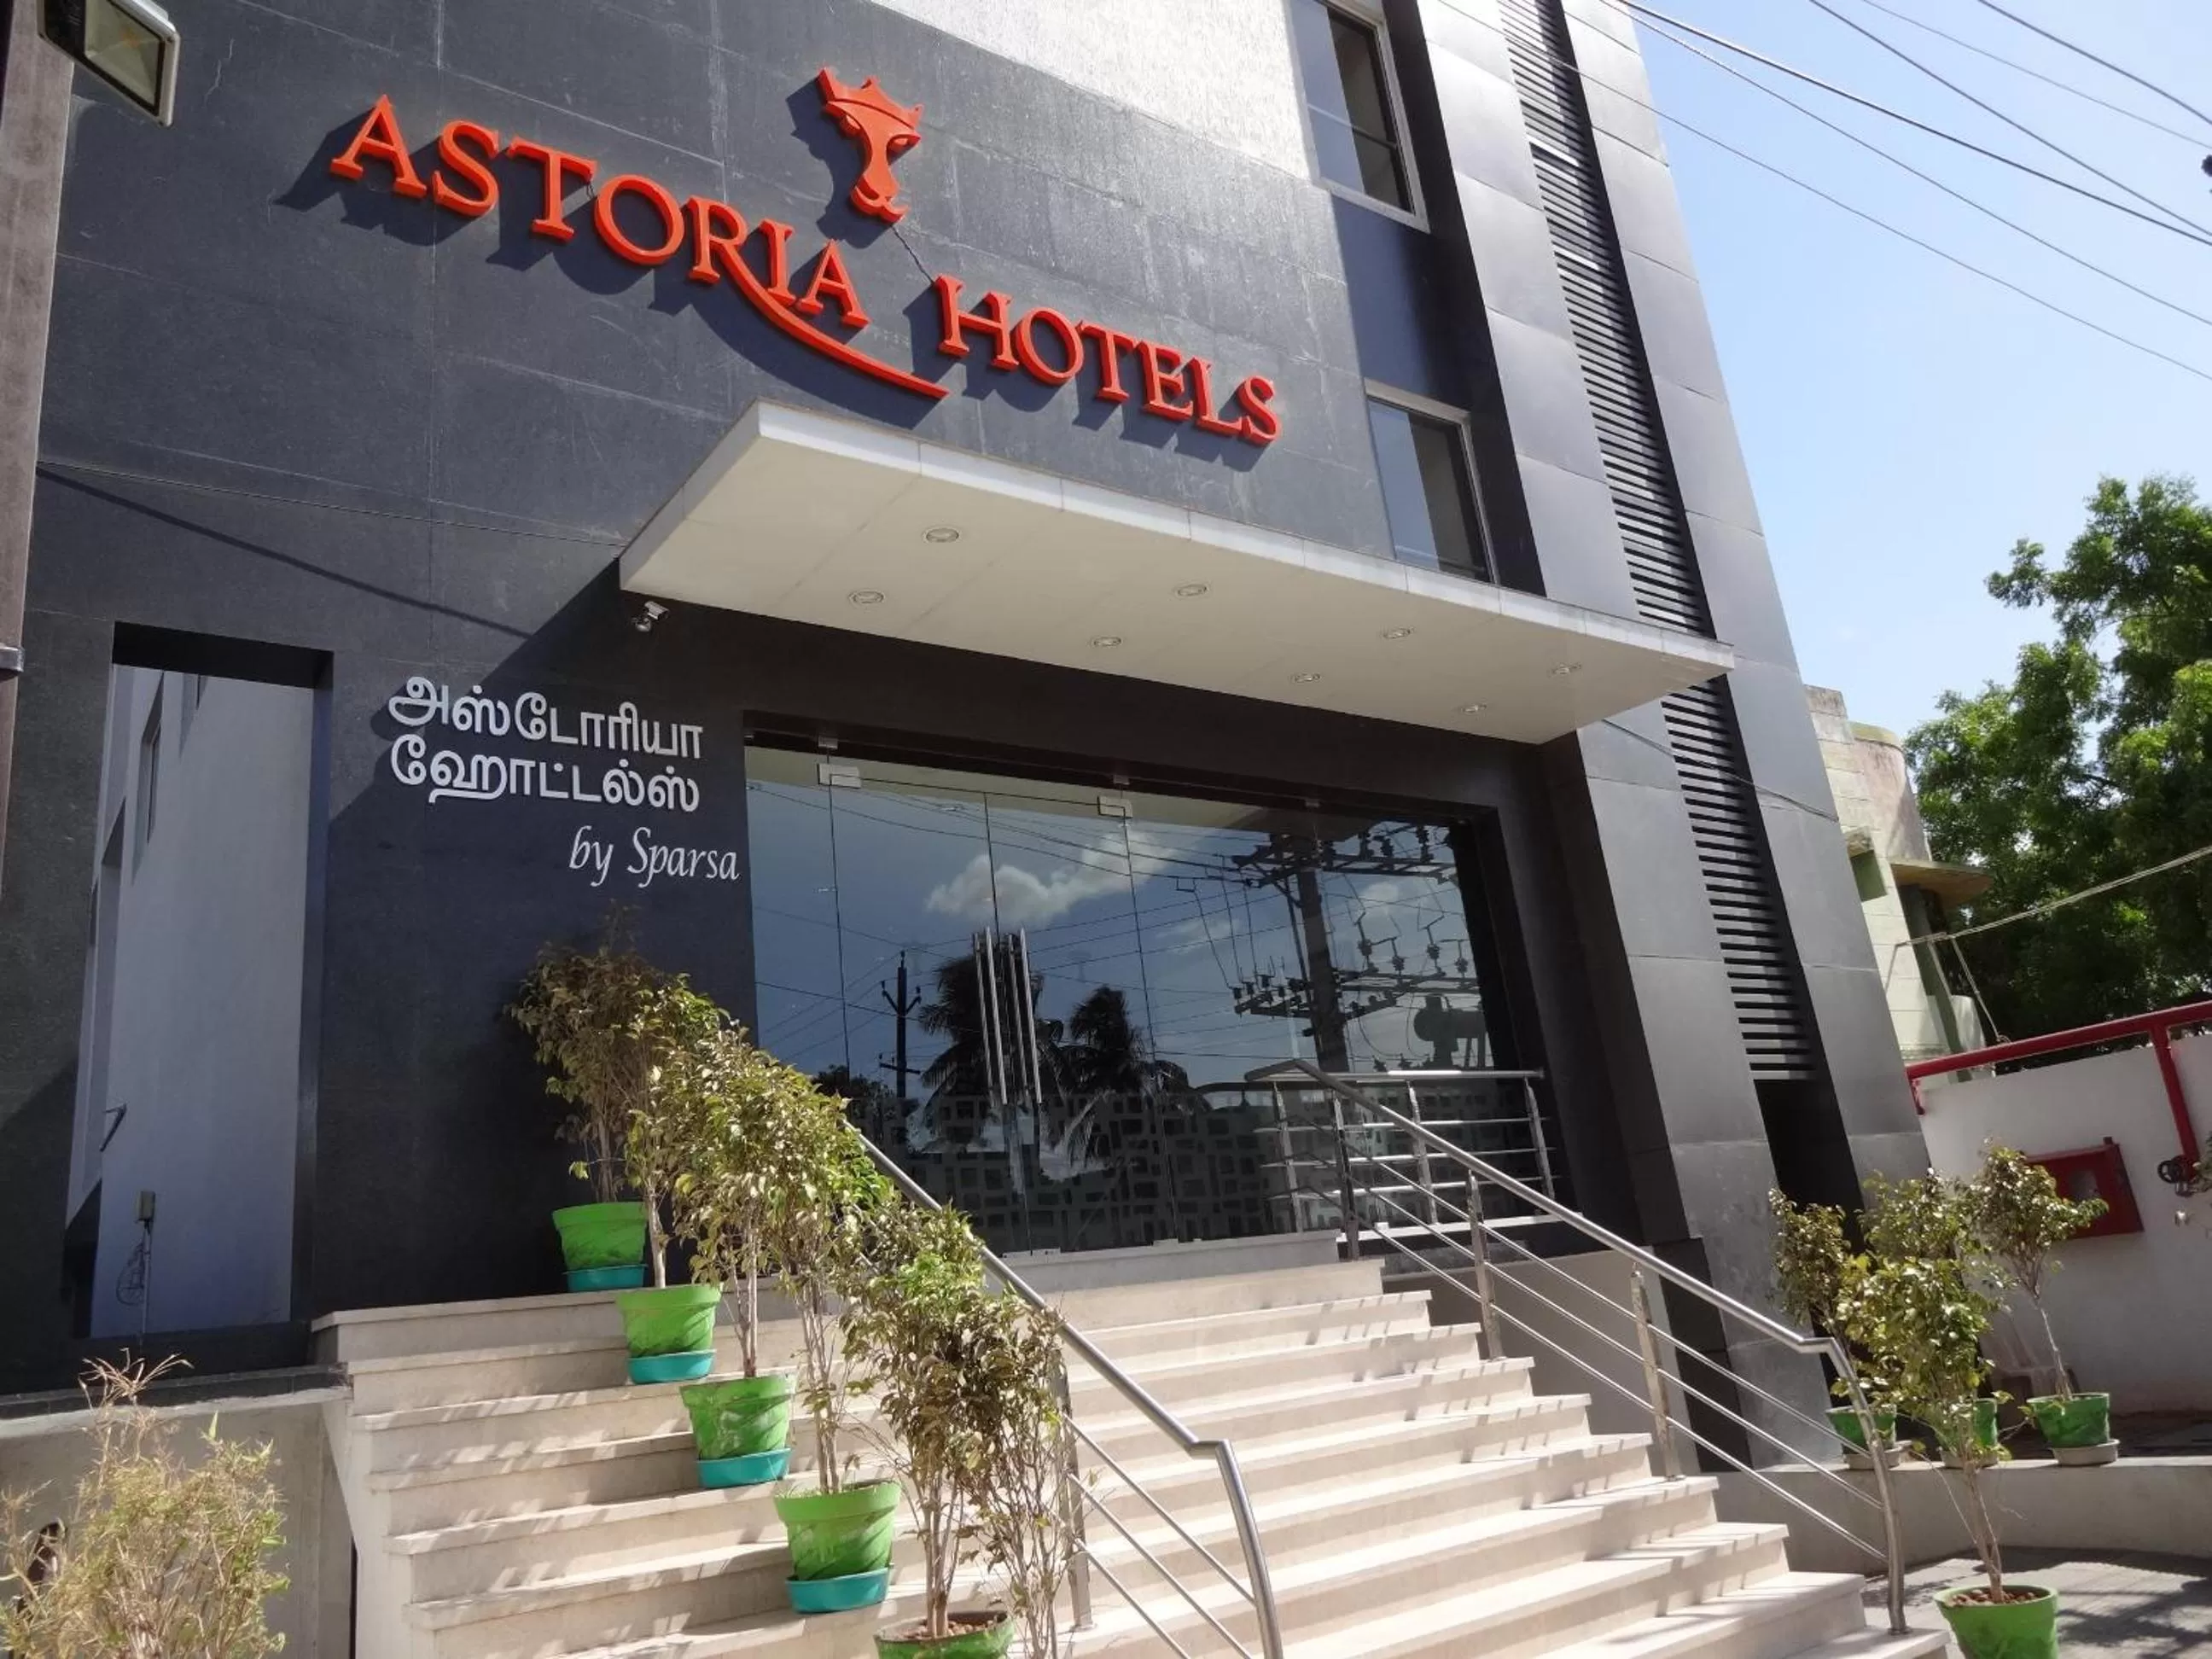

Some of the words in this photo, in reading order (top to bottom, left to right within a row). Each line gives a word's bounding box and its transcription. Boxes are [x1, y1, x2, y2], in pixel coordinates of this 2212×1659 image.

[330, 96, 948, 398] ASTORIA
[935, 275, 1280, 443] HOTELS
[388, 676, 704, 759] அஸ்டோரியா
[391, 734, 700, 812] ஹோட்டல்ஸ்
[568, 825, 614, 888] by
[627, 826, 740, 888] Sparsa
